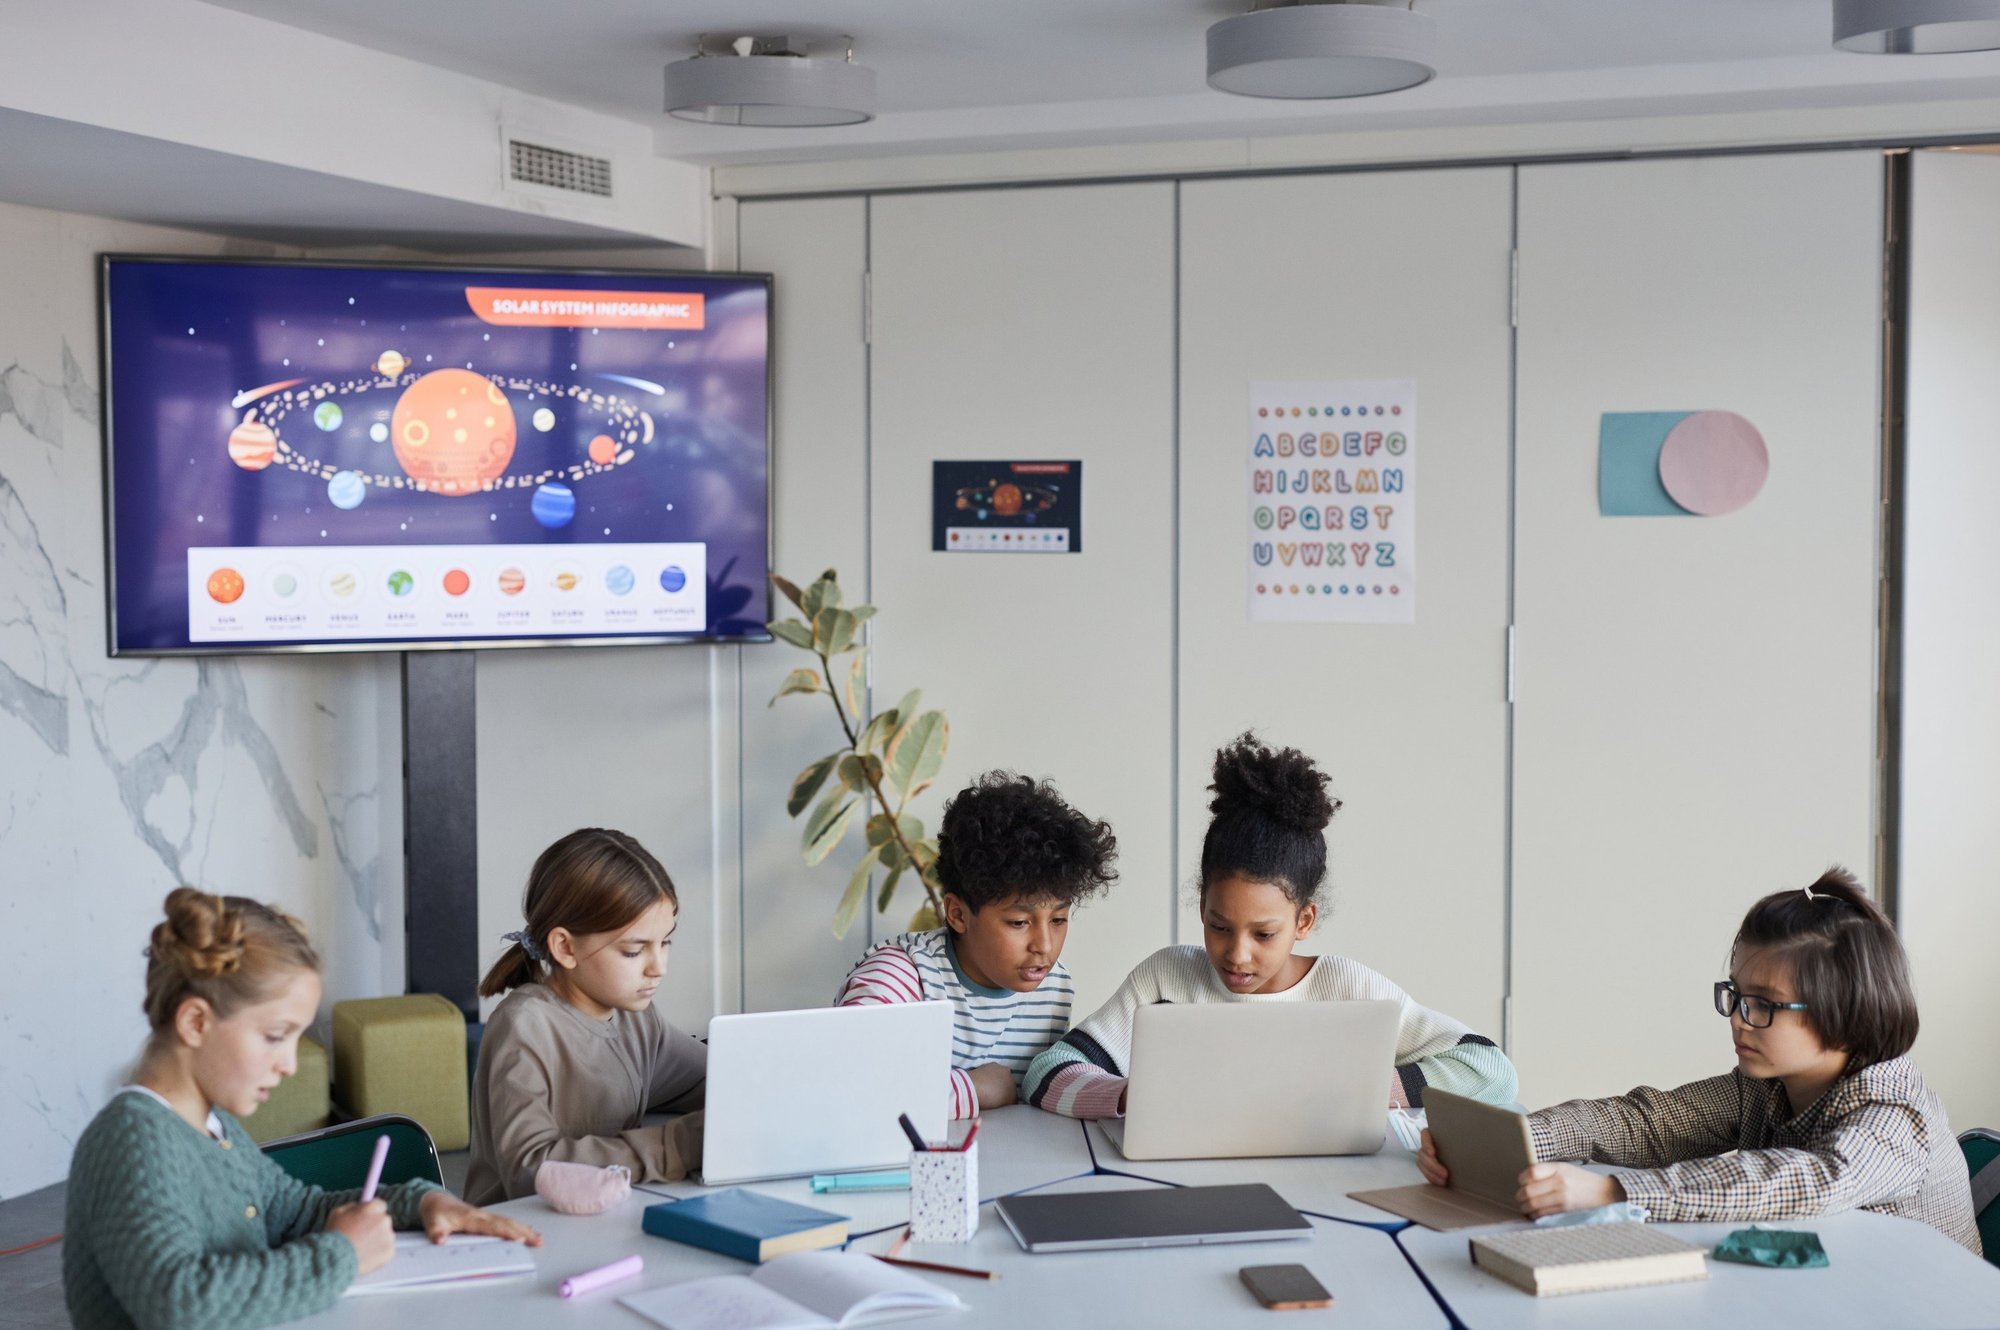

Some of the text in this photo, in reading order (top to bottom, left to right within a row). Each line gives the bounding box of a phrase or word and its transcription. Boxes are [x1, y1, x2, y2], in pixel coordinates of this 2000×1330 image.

[492, 299, 690, 318] SOLAR SYSTEM INFOGRAPHIC
